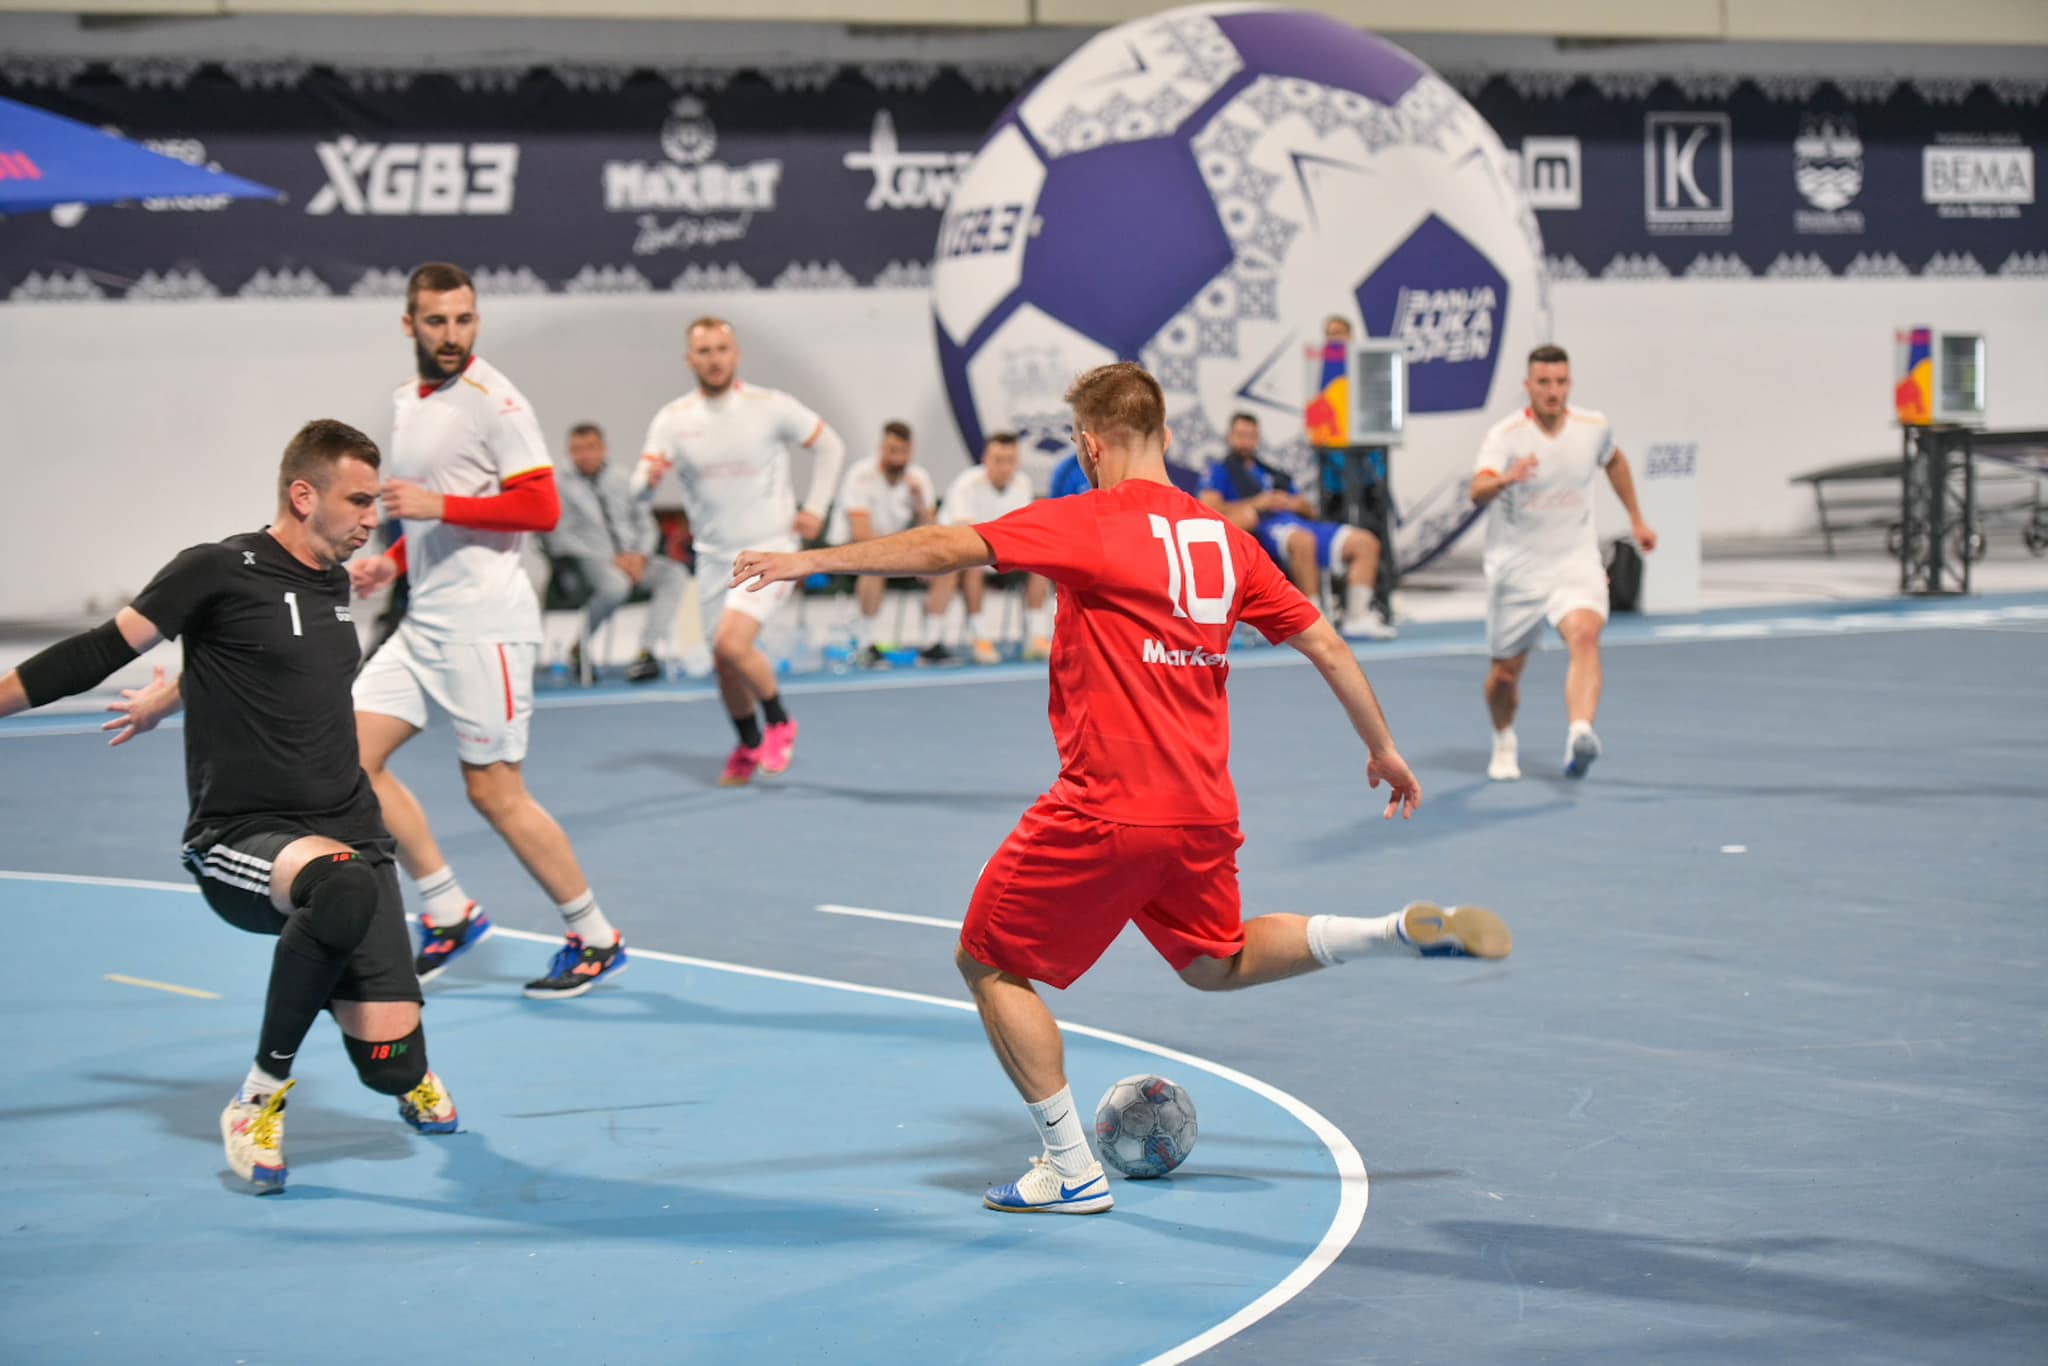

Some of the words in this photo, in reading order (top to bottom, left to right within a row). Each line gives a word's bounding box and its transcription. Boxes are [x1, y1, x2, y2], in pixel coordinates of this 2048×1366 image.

[306, 136, 519, 215] XGB3
[1664, 125, 1712, 208] K
[1931, 154, 2029, 194] BEMA
[1403, 306, 1494, 339] LUKA
[1400, 332, 1490, 363] OPEN
[1147, 513, 1236, 625] 10
[284, 591, 304, 636] 1
